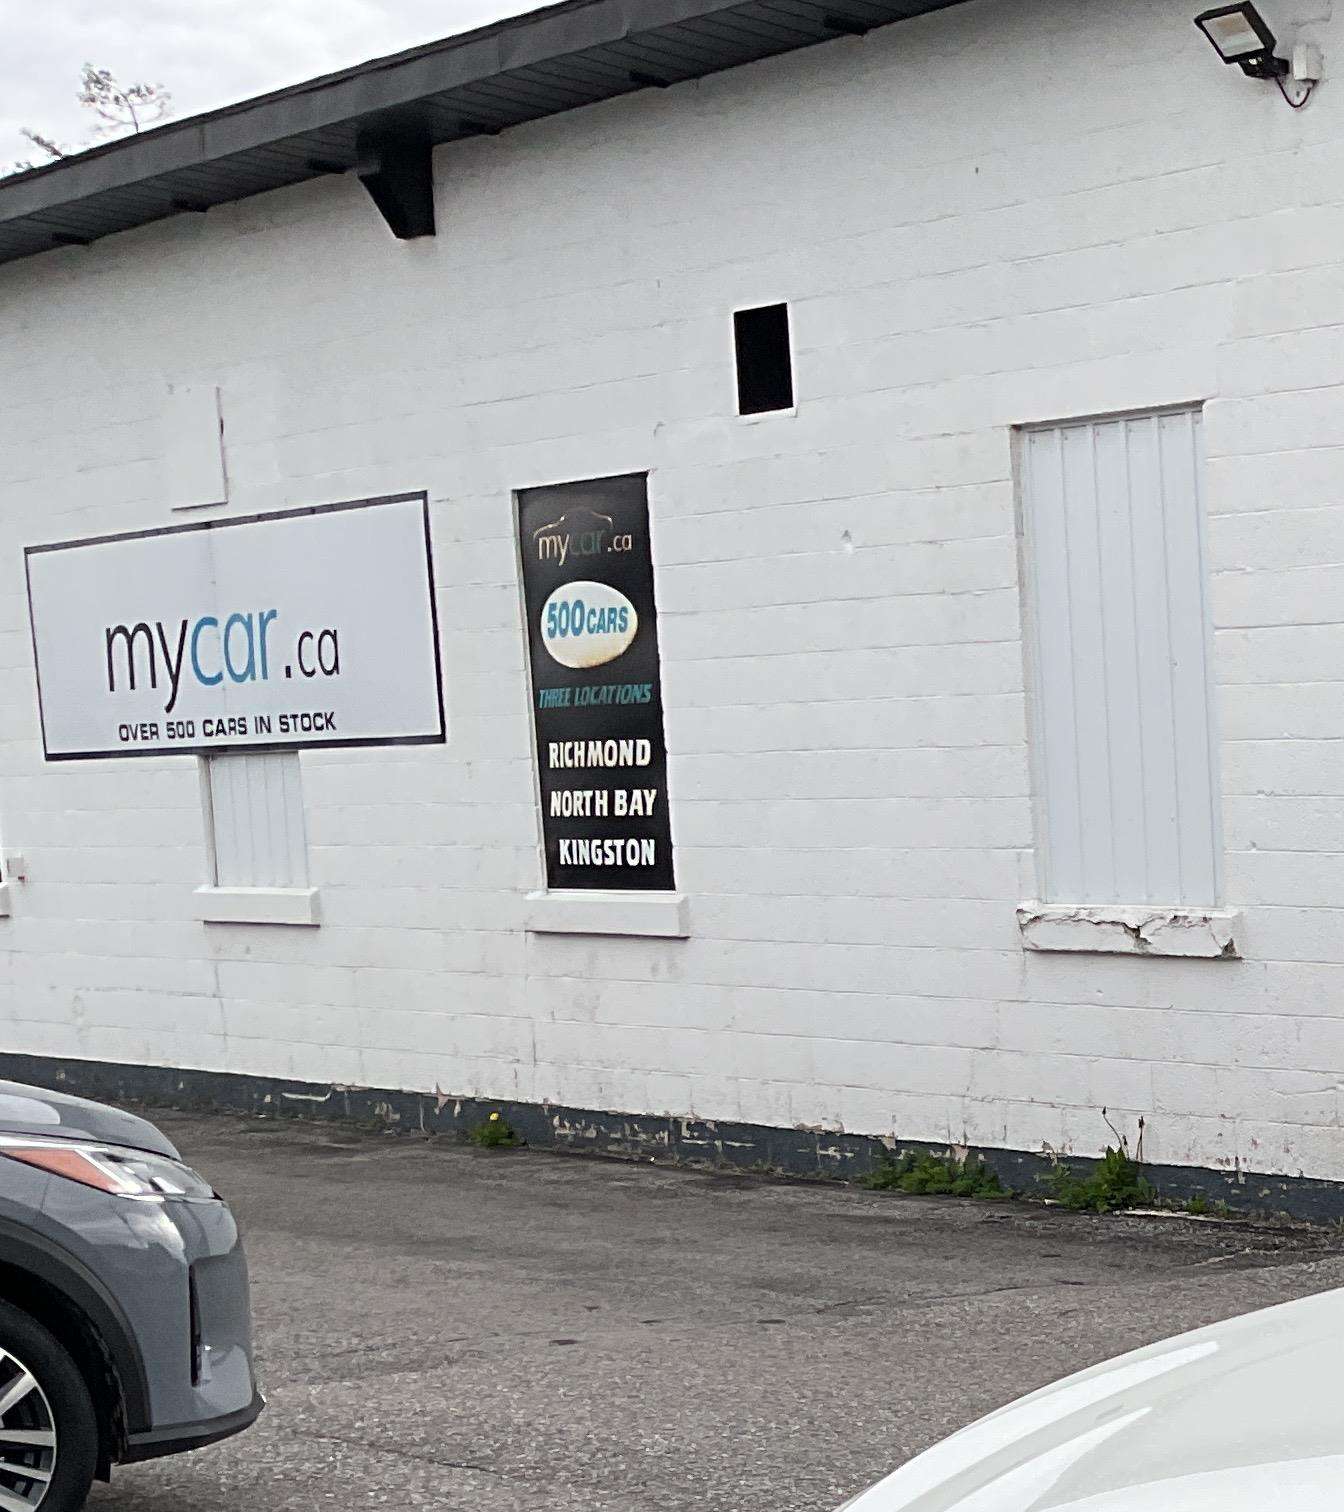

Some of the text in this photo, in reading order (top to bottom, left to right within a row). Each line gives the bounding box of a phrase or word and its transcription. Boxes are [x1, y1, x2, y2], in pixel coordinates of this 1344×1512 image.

[539, 683, 653, 708] THREE LOCATIONS
[118, 711, 337, 741] OVER 500 CARS IN STOCK
[549, 739, 651, 768] RICHMOND
[550, 789, 657, 817] NORTH BAY
[559, 838, 655, 866] KINGSTON
